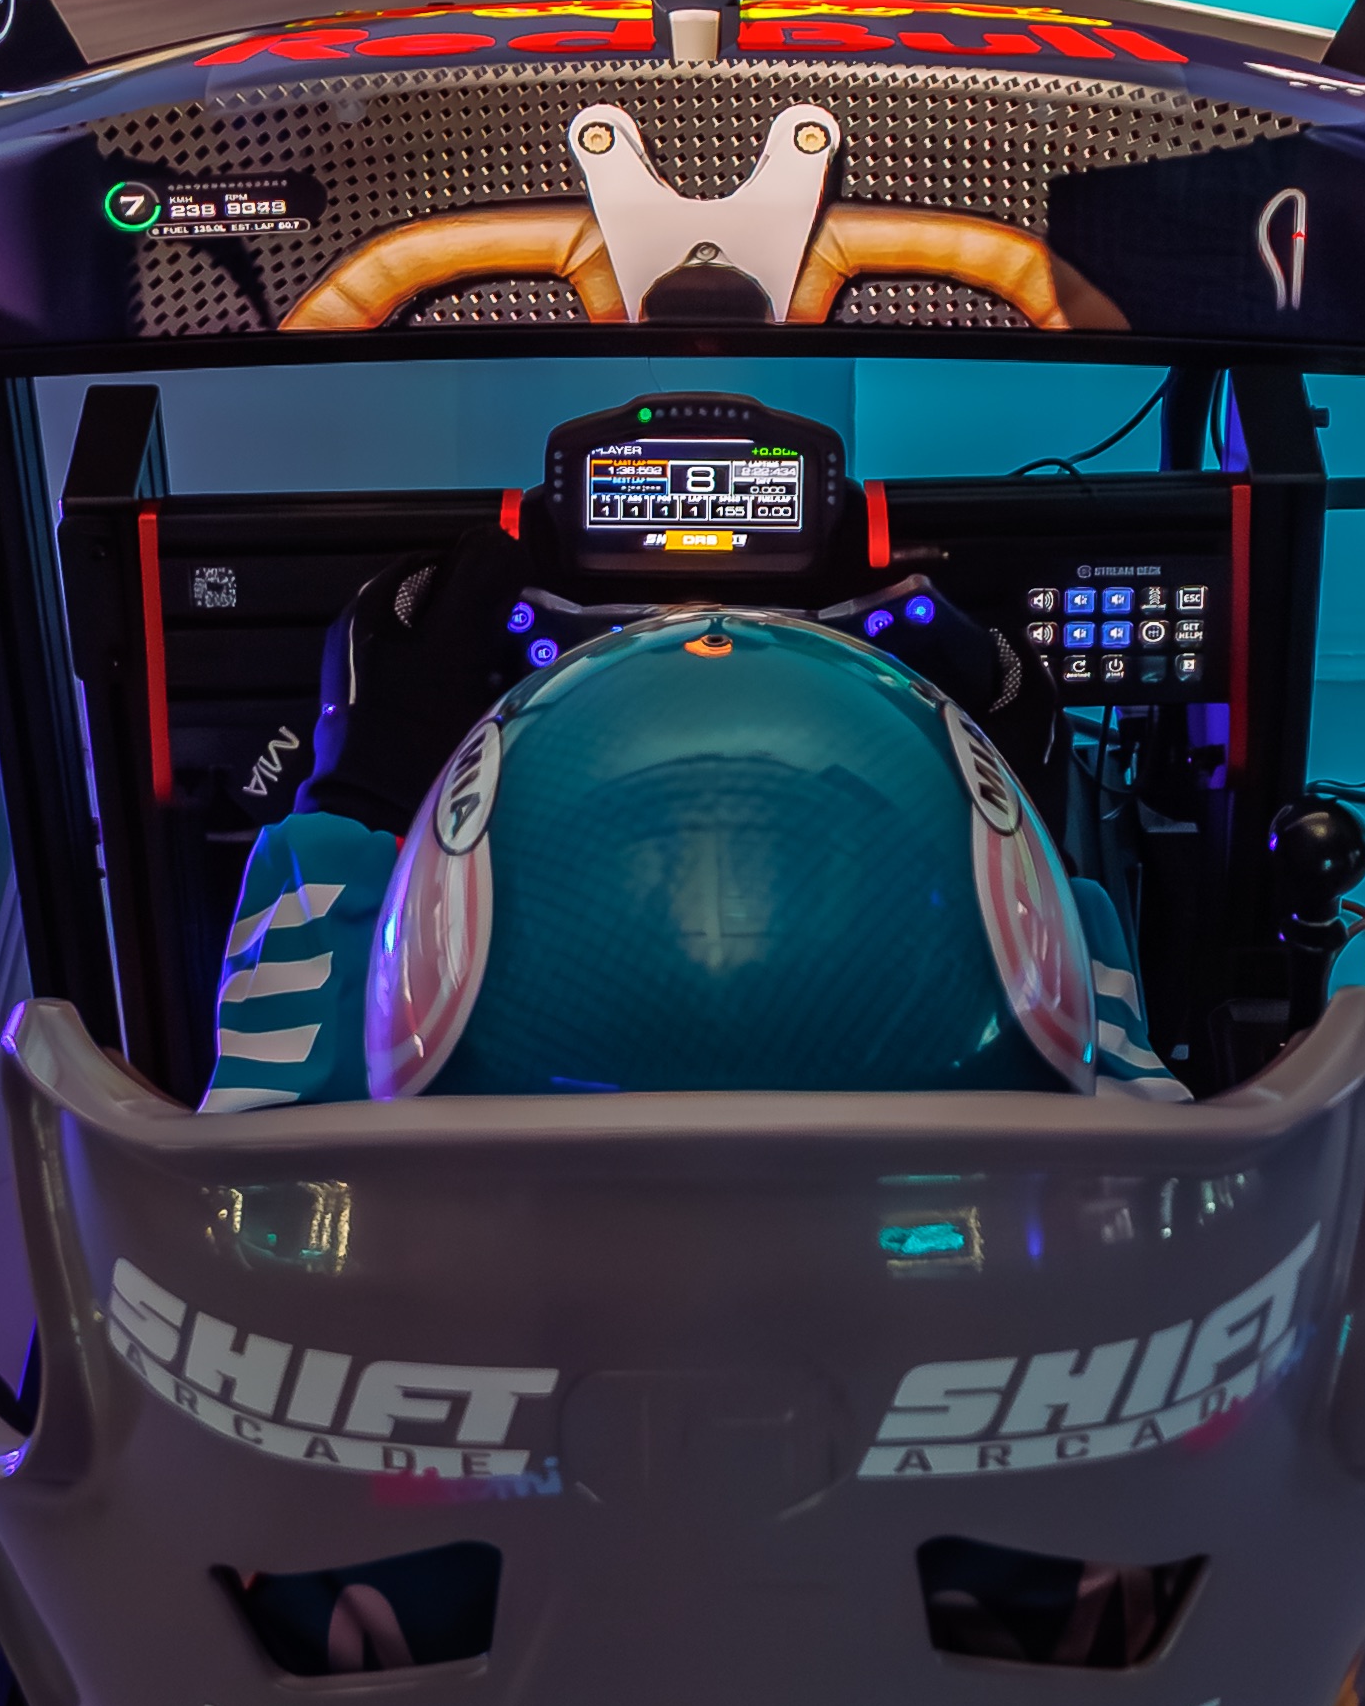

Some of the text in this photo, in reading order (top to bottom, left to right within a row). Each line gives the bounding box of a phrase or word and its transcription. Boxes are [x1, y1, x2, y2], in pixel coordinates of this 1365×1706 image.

[193, 20, 1190, 66] Red Bull
[169, 193, 248, 204] KMH RPM
[119, 194, 145, 216] 7
[163, 226, 189, 235] FUEL
[591, 445, 643, 456] LAYER
[686, 466, 715, 493] 8
[750, 485, 786, 494] 0.000
[601, 505, 610, 516] 1
[630, 505, 639, 516] 1
[660, 505, 669, 516] 1
[689, 505, 699, 516] 1
[757, 506, 792, 516] 0.00
[1183, 593, 1201, 603] ESC
[1182, 623, 1199, 631] GET
[874, 1220, 1321, 1443] SHIFT
[109, 1255, 560, 1445] SHIFT
[124, 1340, 493, 1476] ARCADE
